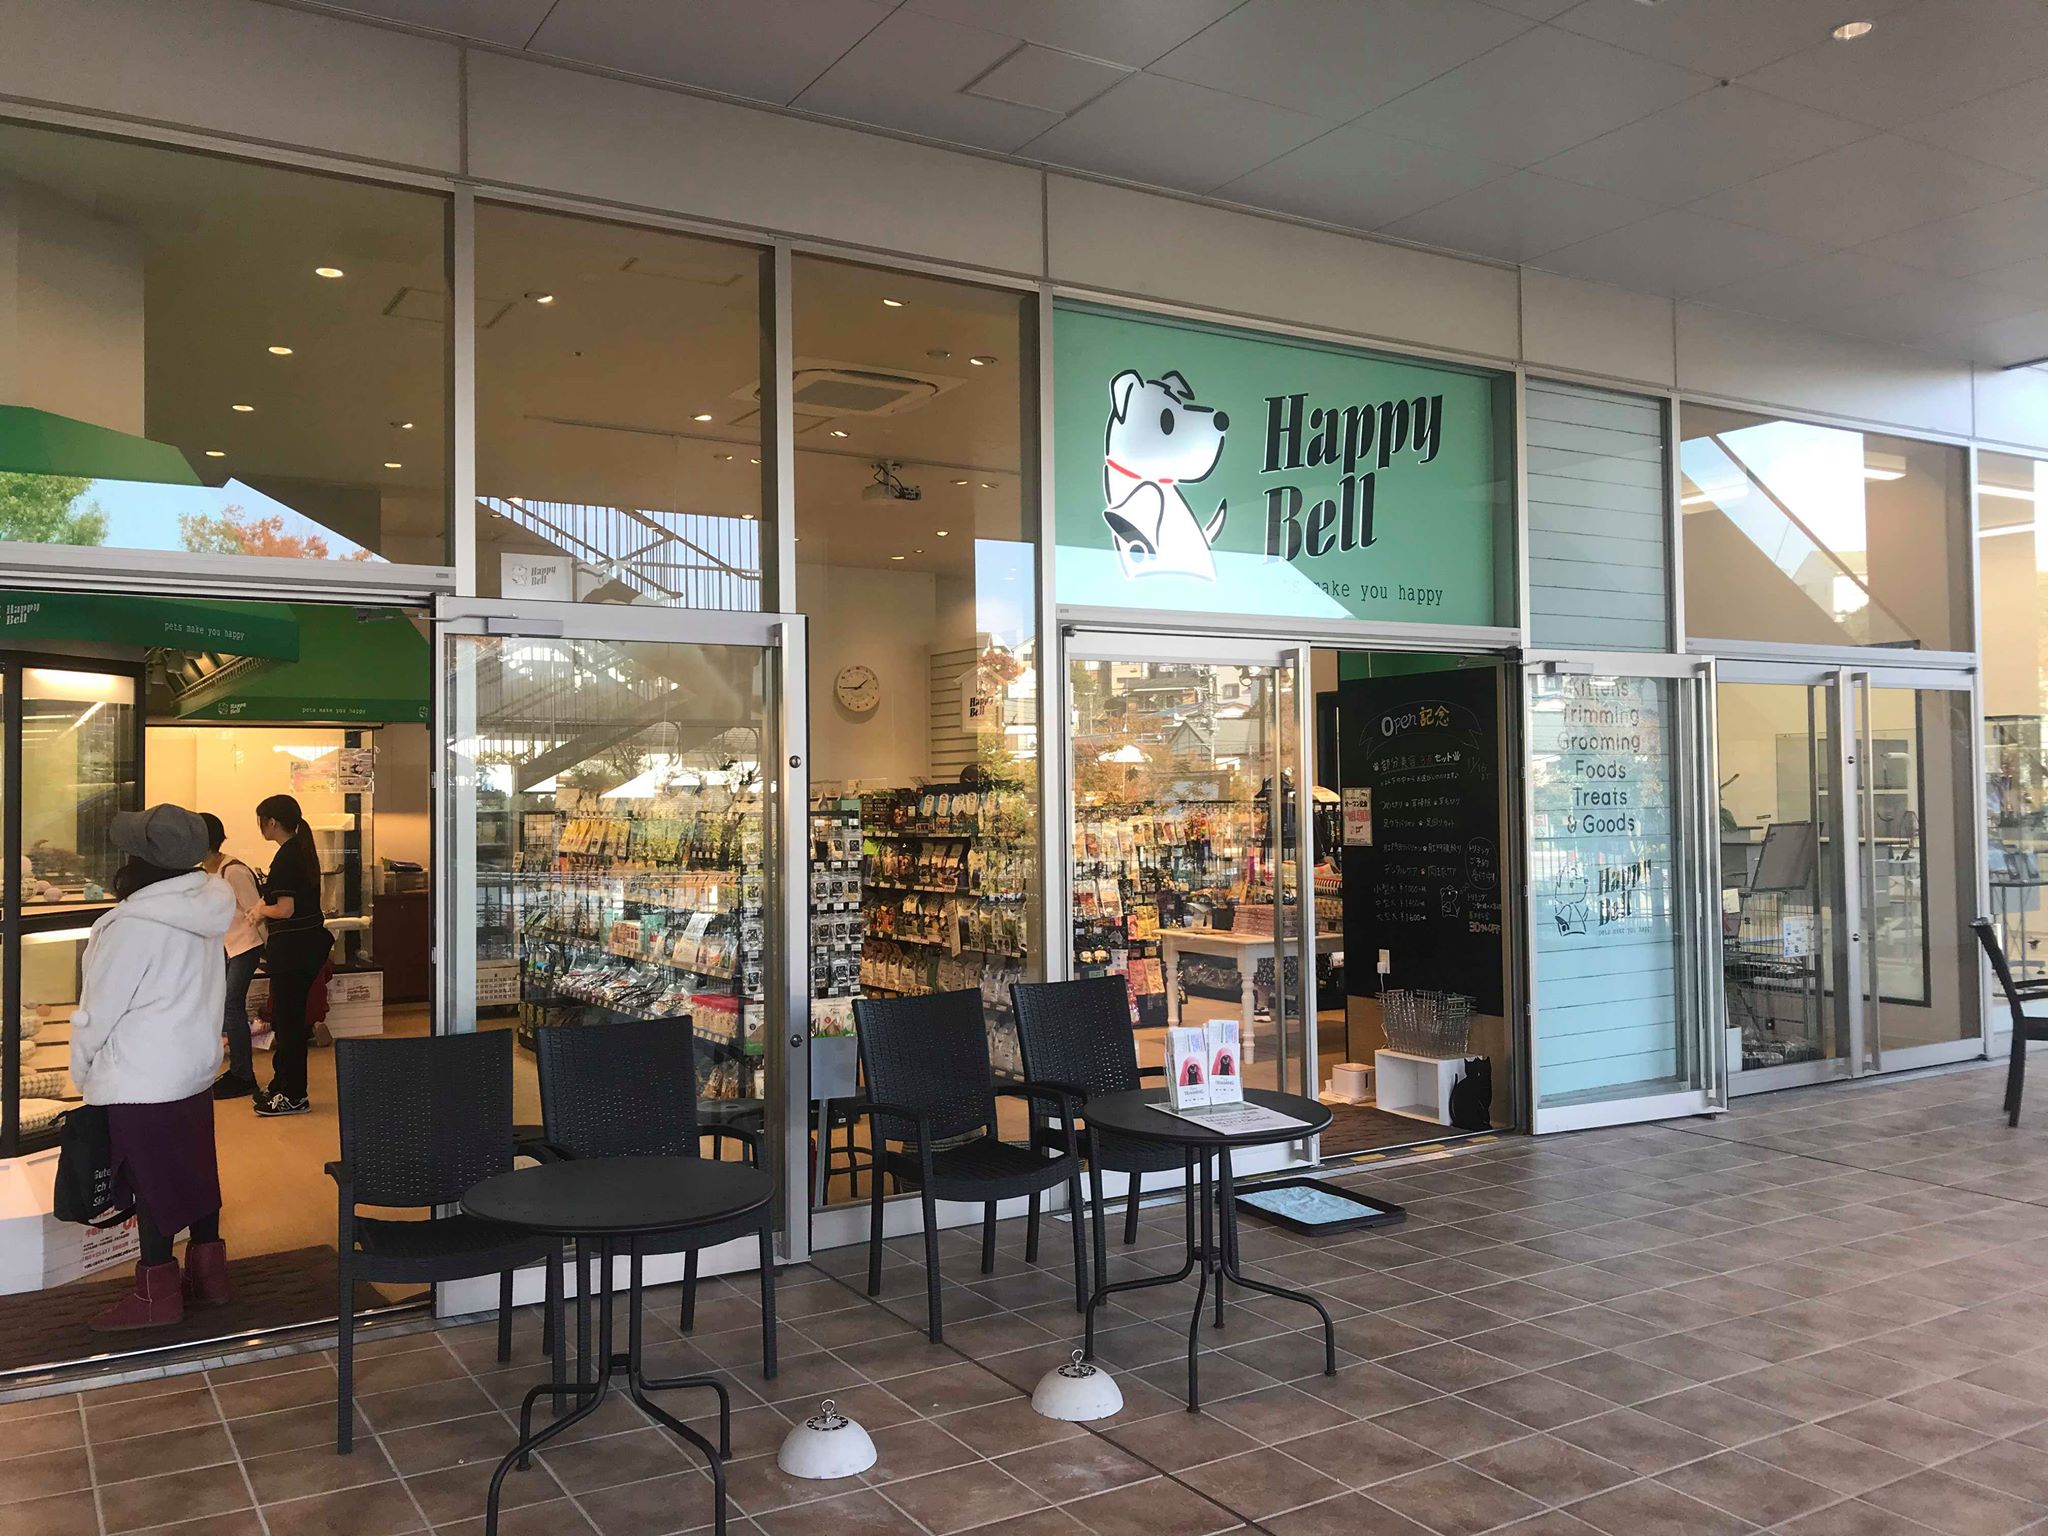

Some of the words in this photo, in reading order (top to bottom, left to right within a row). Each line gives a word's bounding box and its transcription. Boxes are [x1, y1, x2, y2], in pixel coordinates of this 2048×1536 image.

[1259, 392, 1444, 476] Happy
[1262, 470, 1377, 563] Bell
[531, 566, 556, 576] Happy
[531, 575, 547, 586] Bell
[1360, 584, 1388, 602] you
[1398, 584, 1444, 606] happy
[6, 603, 41, 615] Happy
[6, 612, 28, 625] Bell
[164, 622, 183, 632] pets
[186, 624, 205, 635] make
[207, 627, 221, 638] you
[224, 629, 245, 641] happy
[970, 696, 994, 707] Happy
[1381, 712, 1418, 737] Open
[1419, 704, 1450, 728] 記念
[1563, 703, 1640, 727] Trimming
[1557, 731, 1641, 754] Grooming
[1575, 760, 1627, 780] Foods
[1573, 786, 1628, 806] Treats
[1582, 814, 1635, 834] Goods
[1598, 889, 1632, 927] Bell
